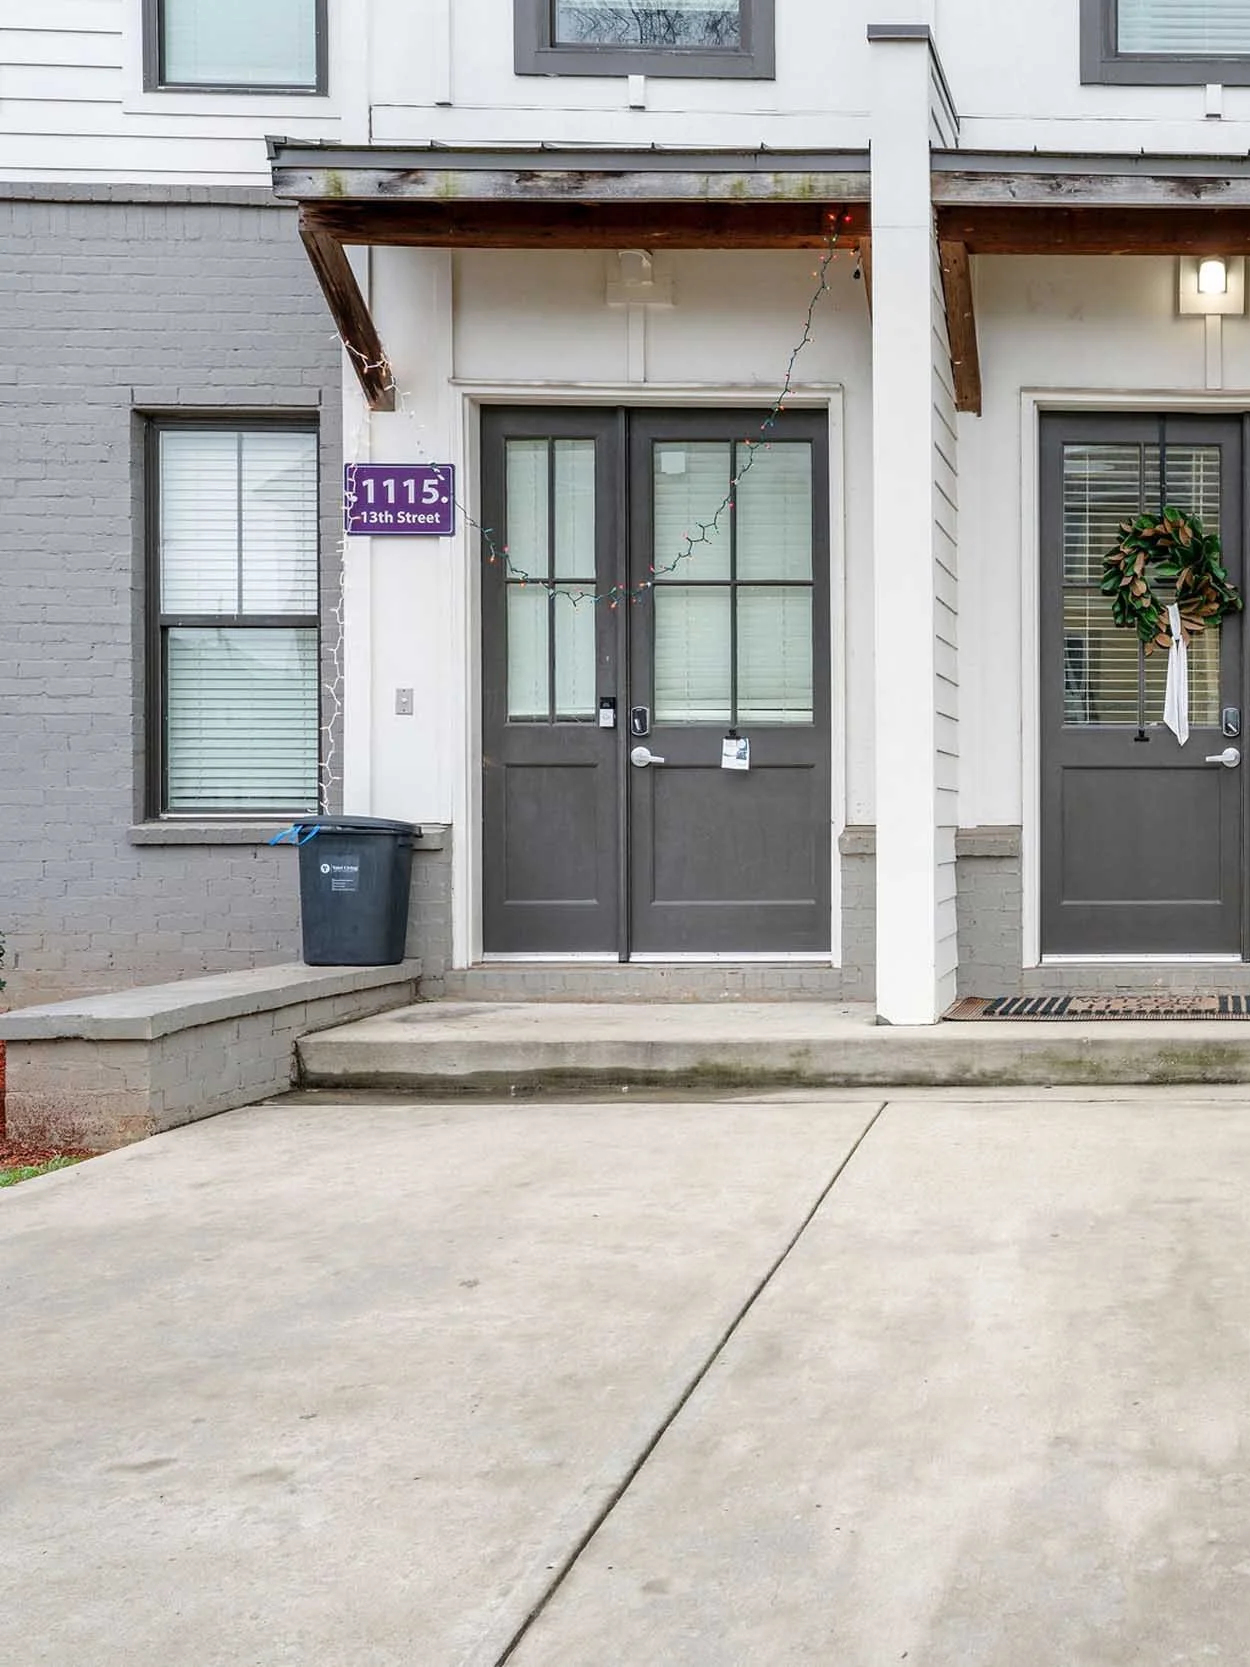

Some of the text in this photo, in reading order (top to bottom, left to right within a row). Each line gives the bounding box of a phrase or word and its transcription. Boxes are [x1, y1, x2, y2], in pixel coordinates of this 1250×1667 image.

[362, 478, 440, 504] 1115
[360, 510, 441, 524] 13th Street
